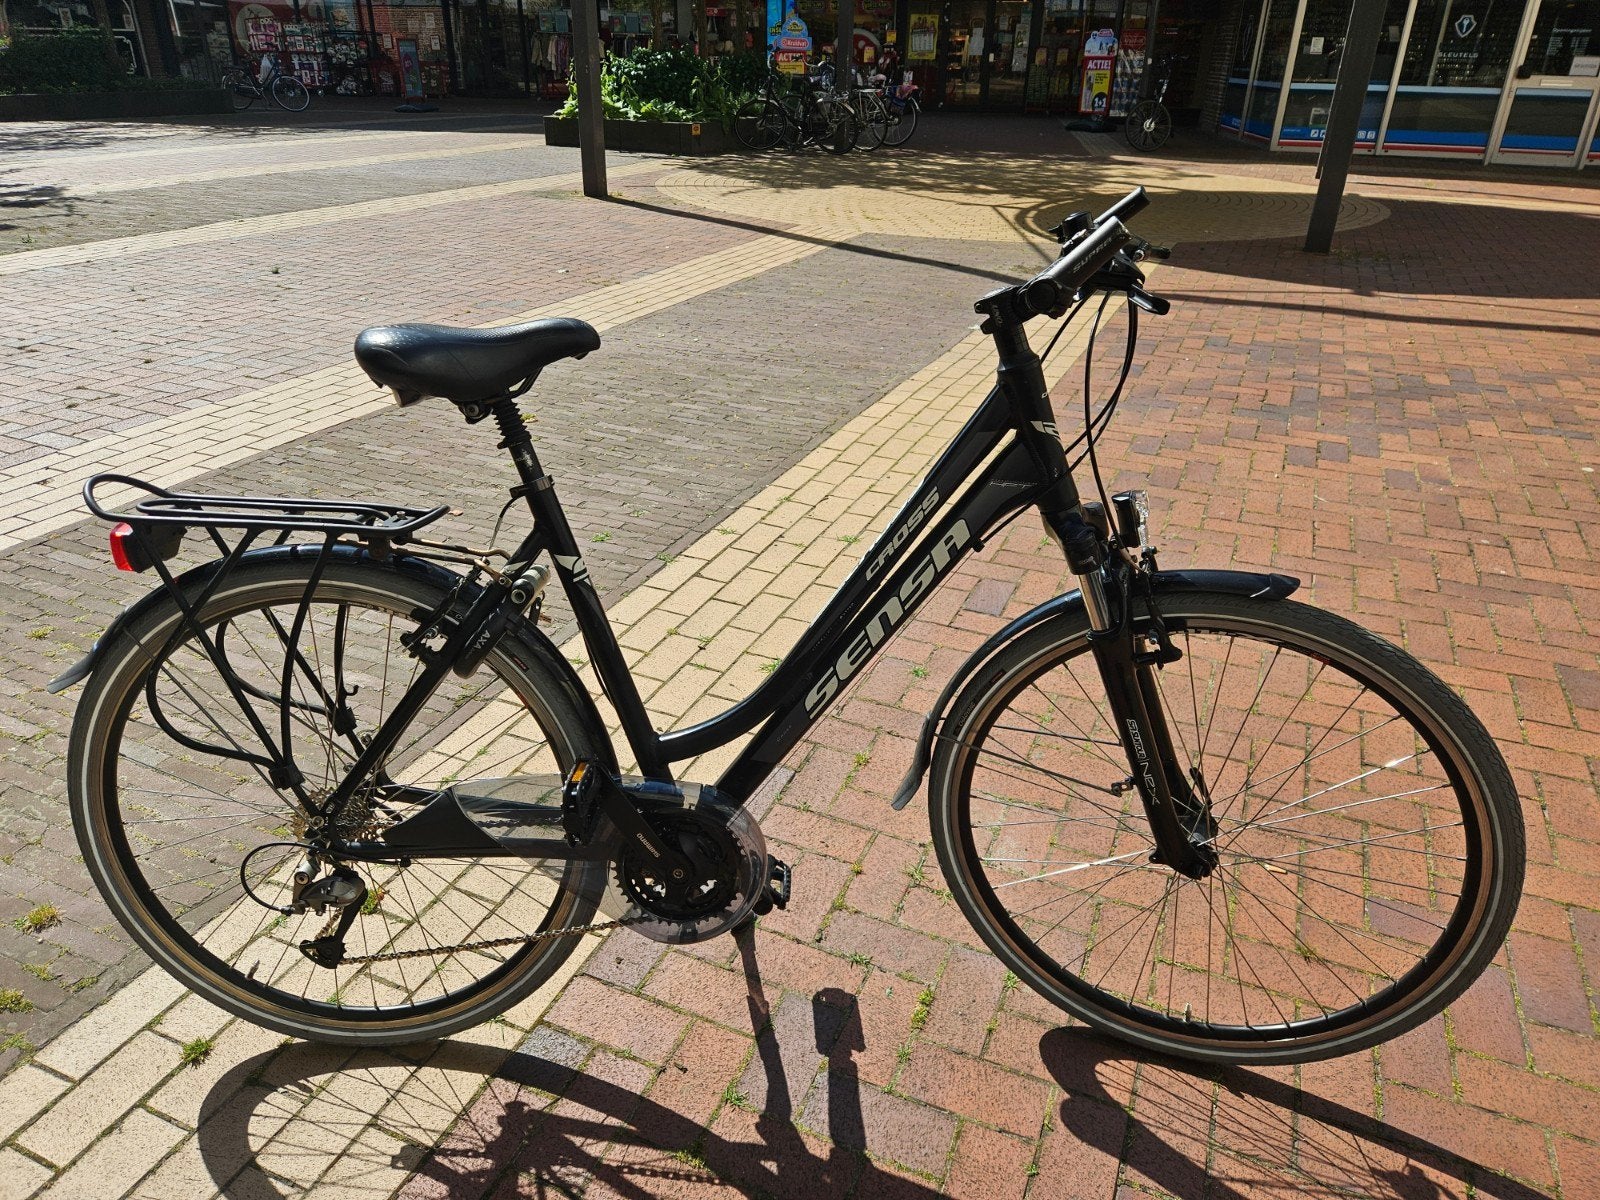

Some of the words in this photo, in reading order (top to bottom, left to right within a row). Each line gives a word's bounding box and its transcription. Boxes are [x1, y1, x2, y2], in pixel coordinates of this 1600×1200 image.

[1087, 59, 1112, 70] ACTIE!
[866, 486, 940, 581] CROSS
[474, 630, 491, 650] AXA
